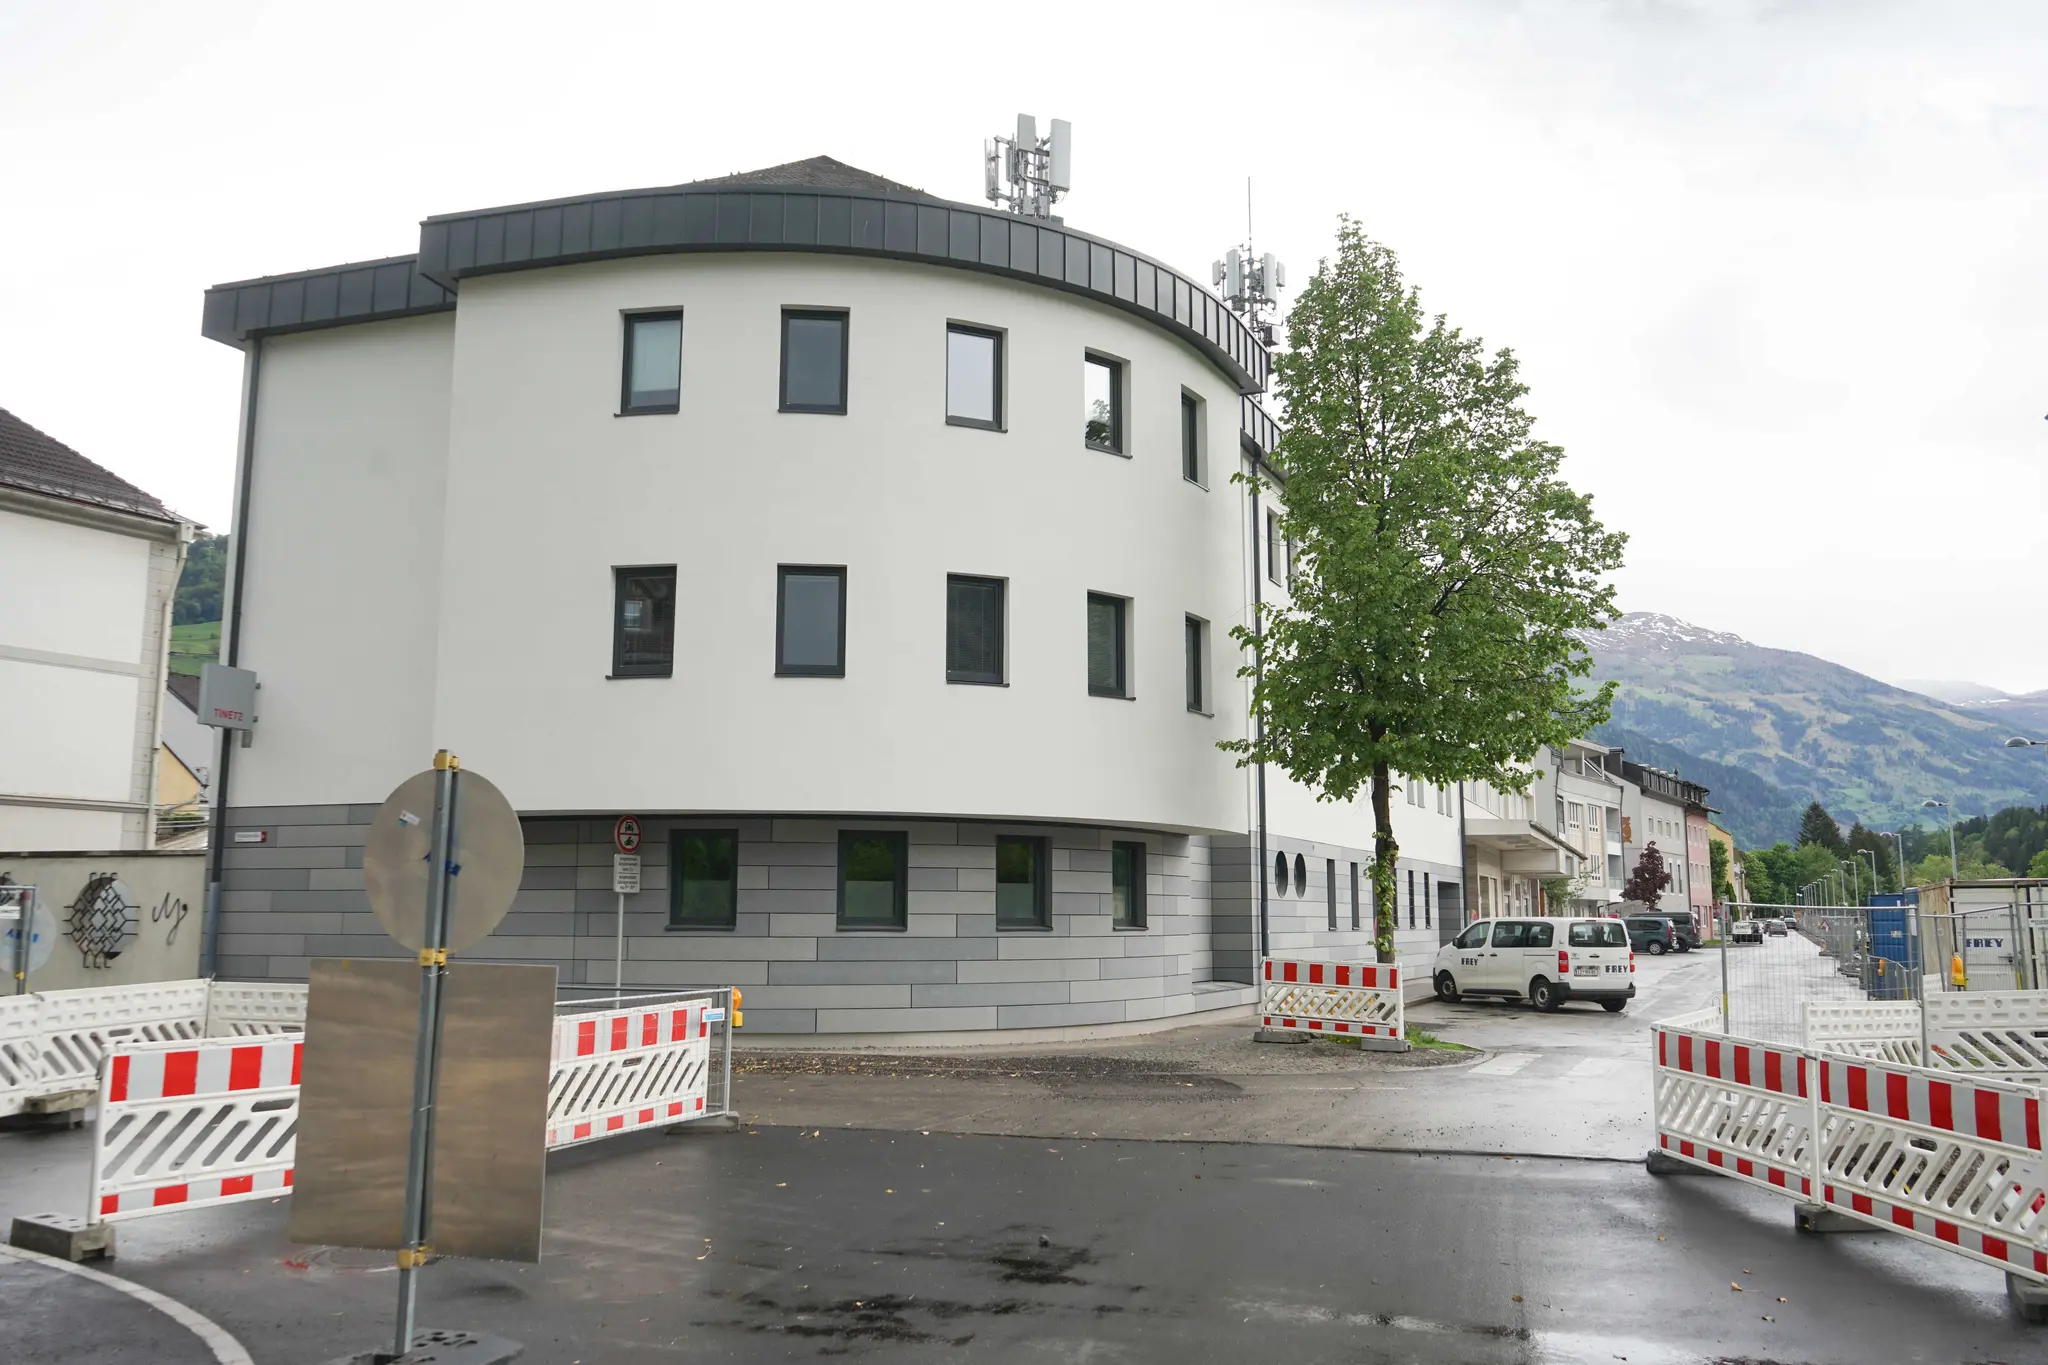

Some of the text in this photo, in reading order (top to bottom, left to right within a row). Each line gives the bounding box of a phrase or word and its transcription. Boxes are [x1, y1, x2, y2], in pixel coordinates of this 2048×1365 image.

[213, 708, 243, 722] TINETZ
[1965, 938, 2004, 948] FREY
[1461, 957, 1479, 966] FREY
[1605, 965, 1628, 973] FREY
